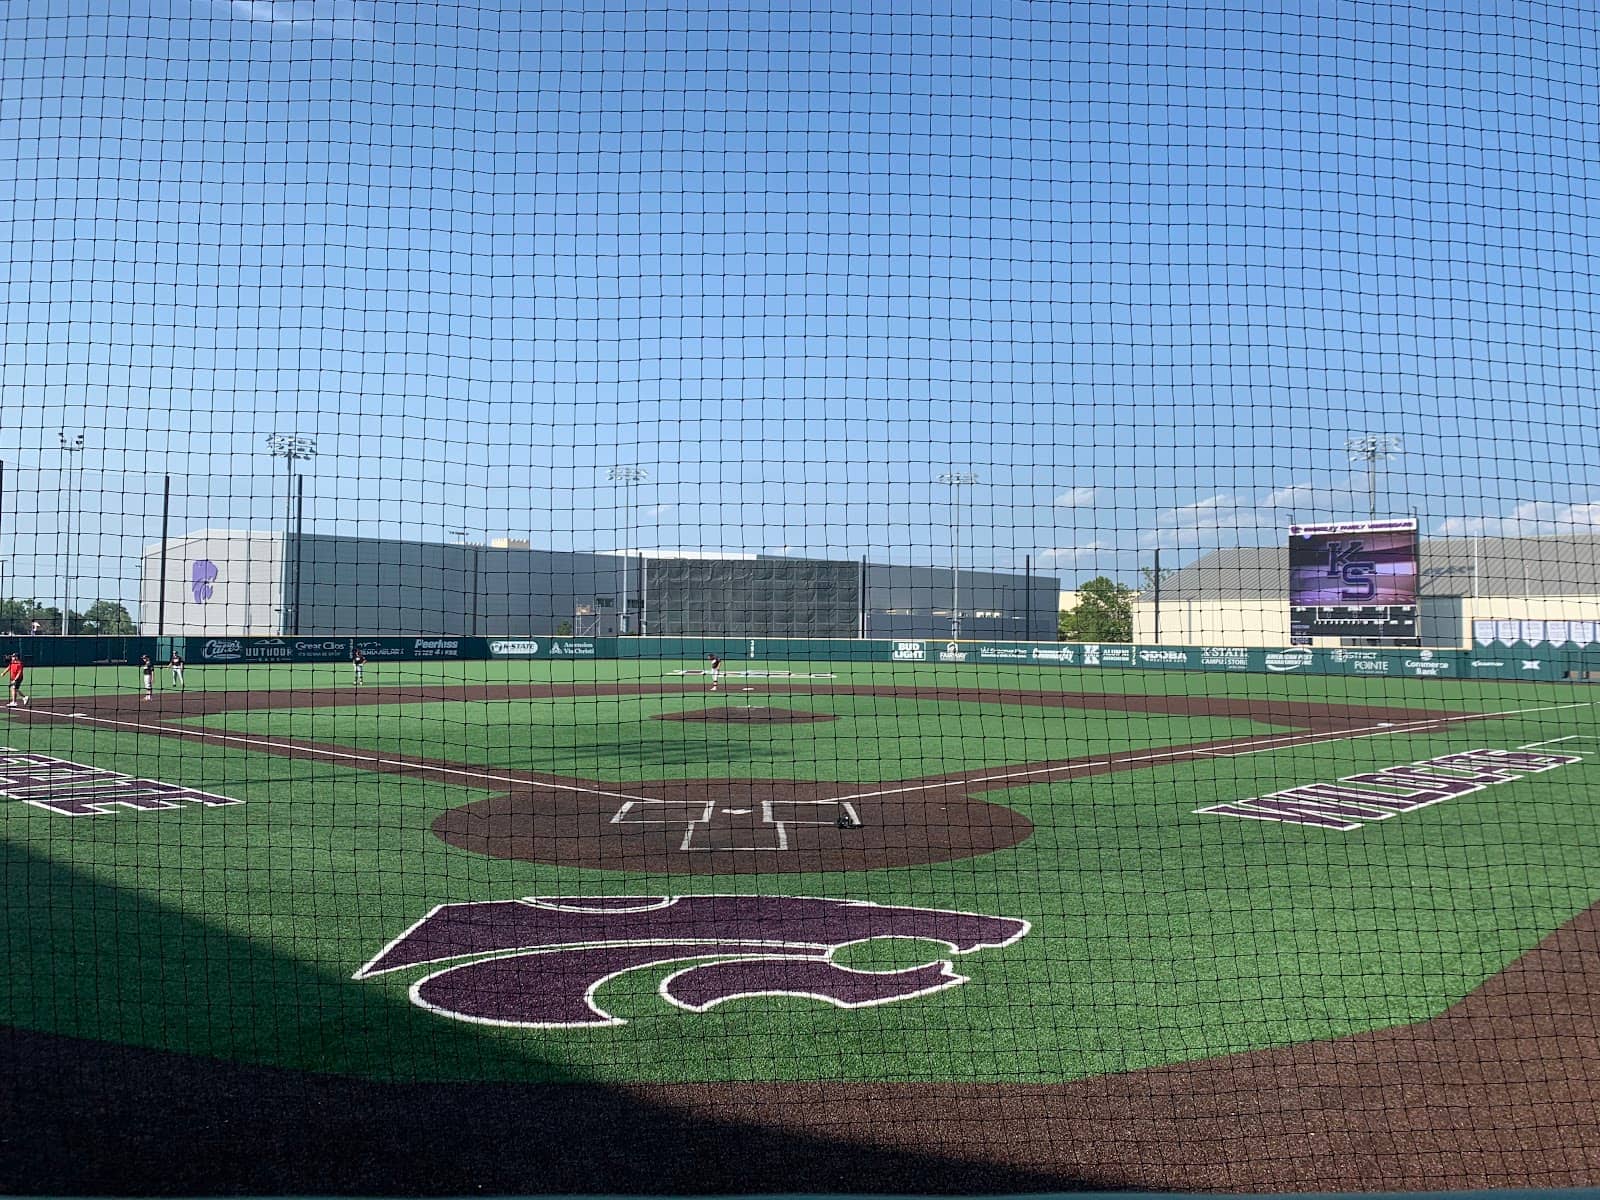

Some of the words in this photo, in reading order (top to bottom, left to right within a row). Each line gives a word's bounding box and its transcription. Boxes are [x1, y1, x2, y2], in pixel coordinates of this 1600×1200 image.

[295, 642, 322, 650] Great
[414, 639, 458, 648] Peerless
[894, 651, 924, 659] LIGHT
[1140, 650, 1187, 660] QDOBA
[1200, 648, 1248, 657] K-STATE
[1354, 661, 1389, 670] POINTE
[1405, 660, 1449, 668] Commerce
[1192, 748, 1583, 831] WILDCATS
